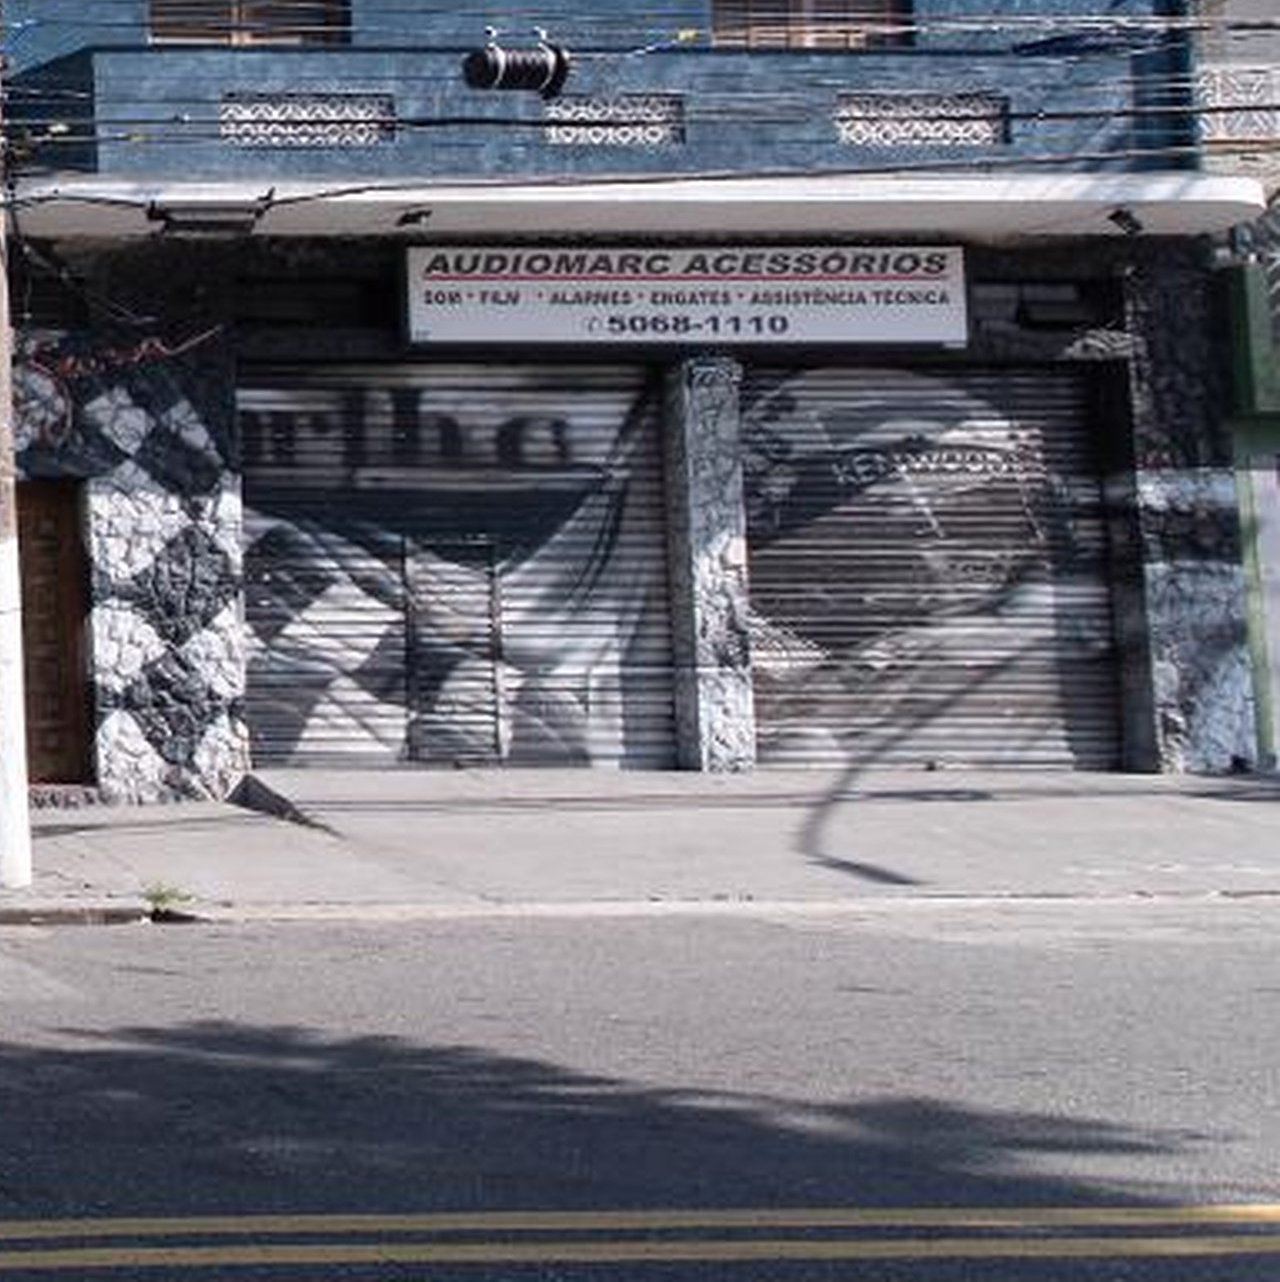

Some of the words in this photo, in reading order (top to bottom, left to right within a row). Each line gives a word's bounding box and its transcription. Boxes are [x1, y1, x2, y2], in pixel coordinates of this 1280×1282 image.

[425, 253, 671, 274] AUDIOMARC
[683, 251, 947, 275] ACESSÓRIOS
[549, 289, 632, 306] ALARMES
[649, 289, 731, 306] ENGATES
[750, 287, 867, 306] ASSISTÊNCIA
[606, 315, 790, 335] 5068-1110
